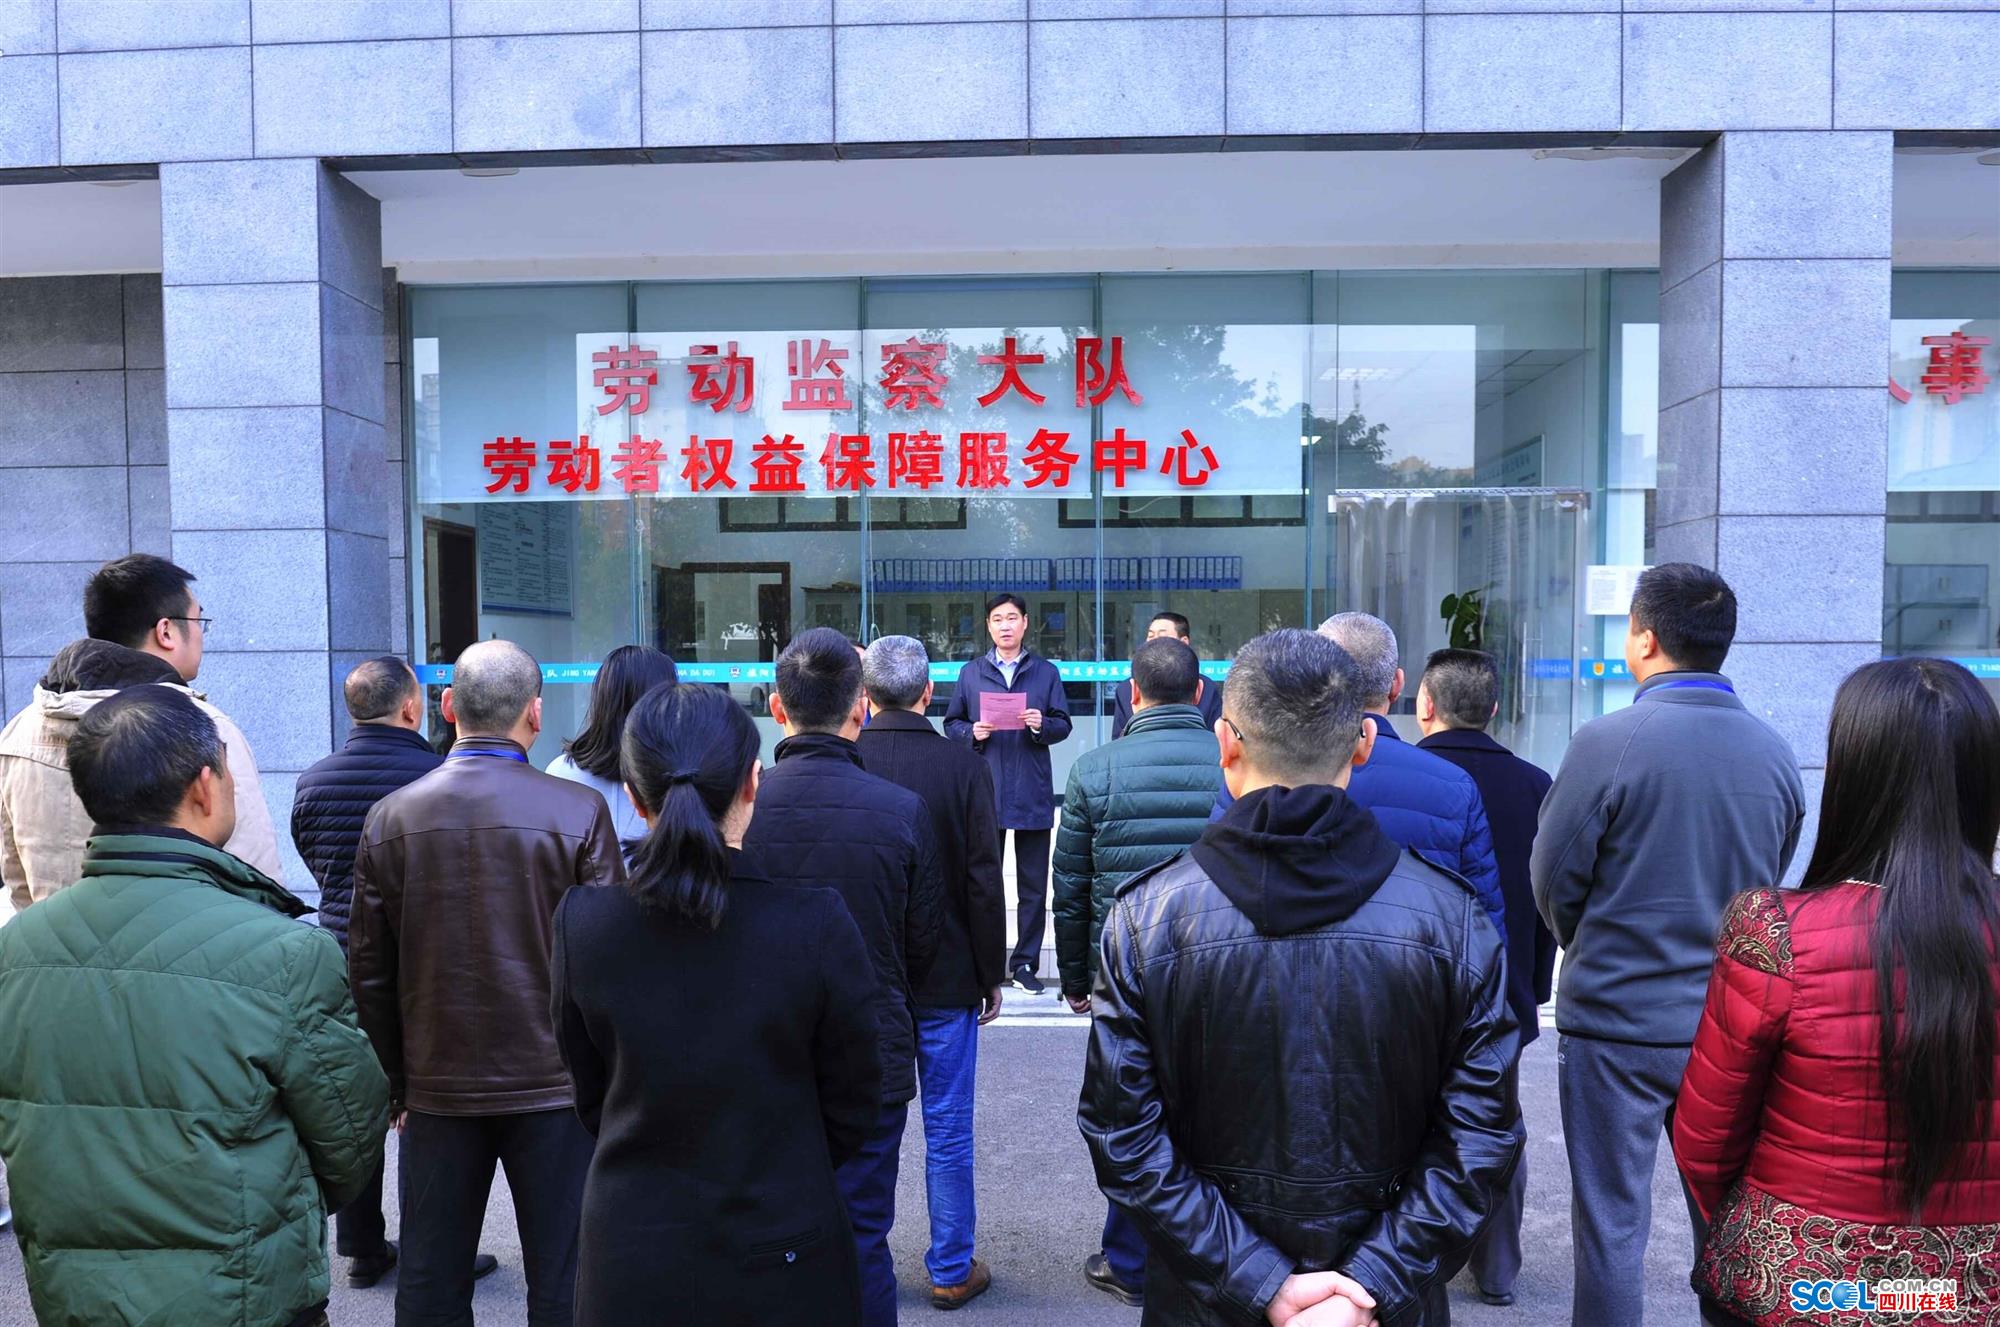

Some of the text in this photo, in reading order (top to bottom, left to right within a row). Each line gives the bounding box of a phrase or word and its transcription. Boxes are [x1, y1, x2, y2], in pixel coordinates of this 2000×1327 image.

[592, 336, 1143, 416] 劳动监察大队
[483, 428, 1220, 494] 劳动者权益保障服务中心
